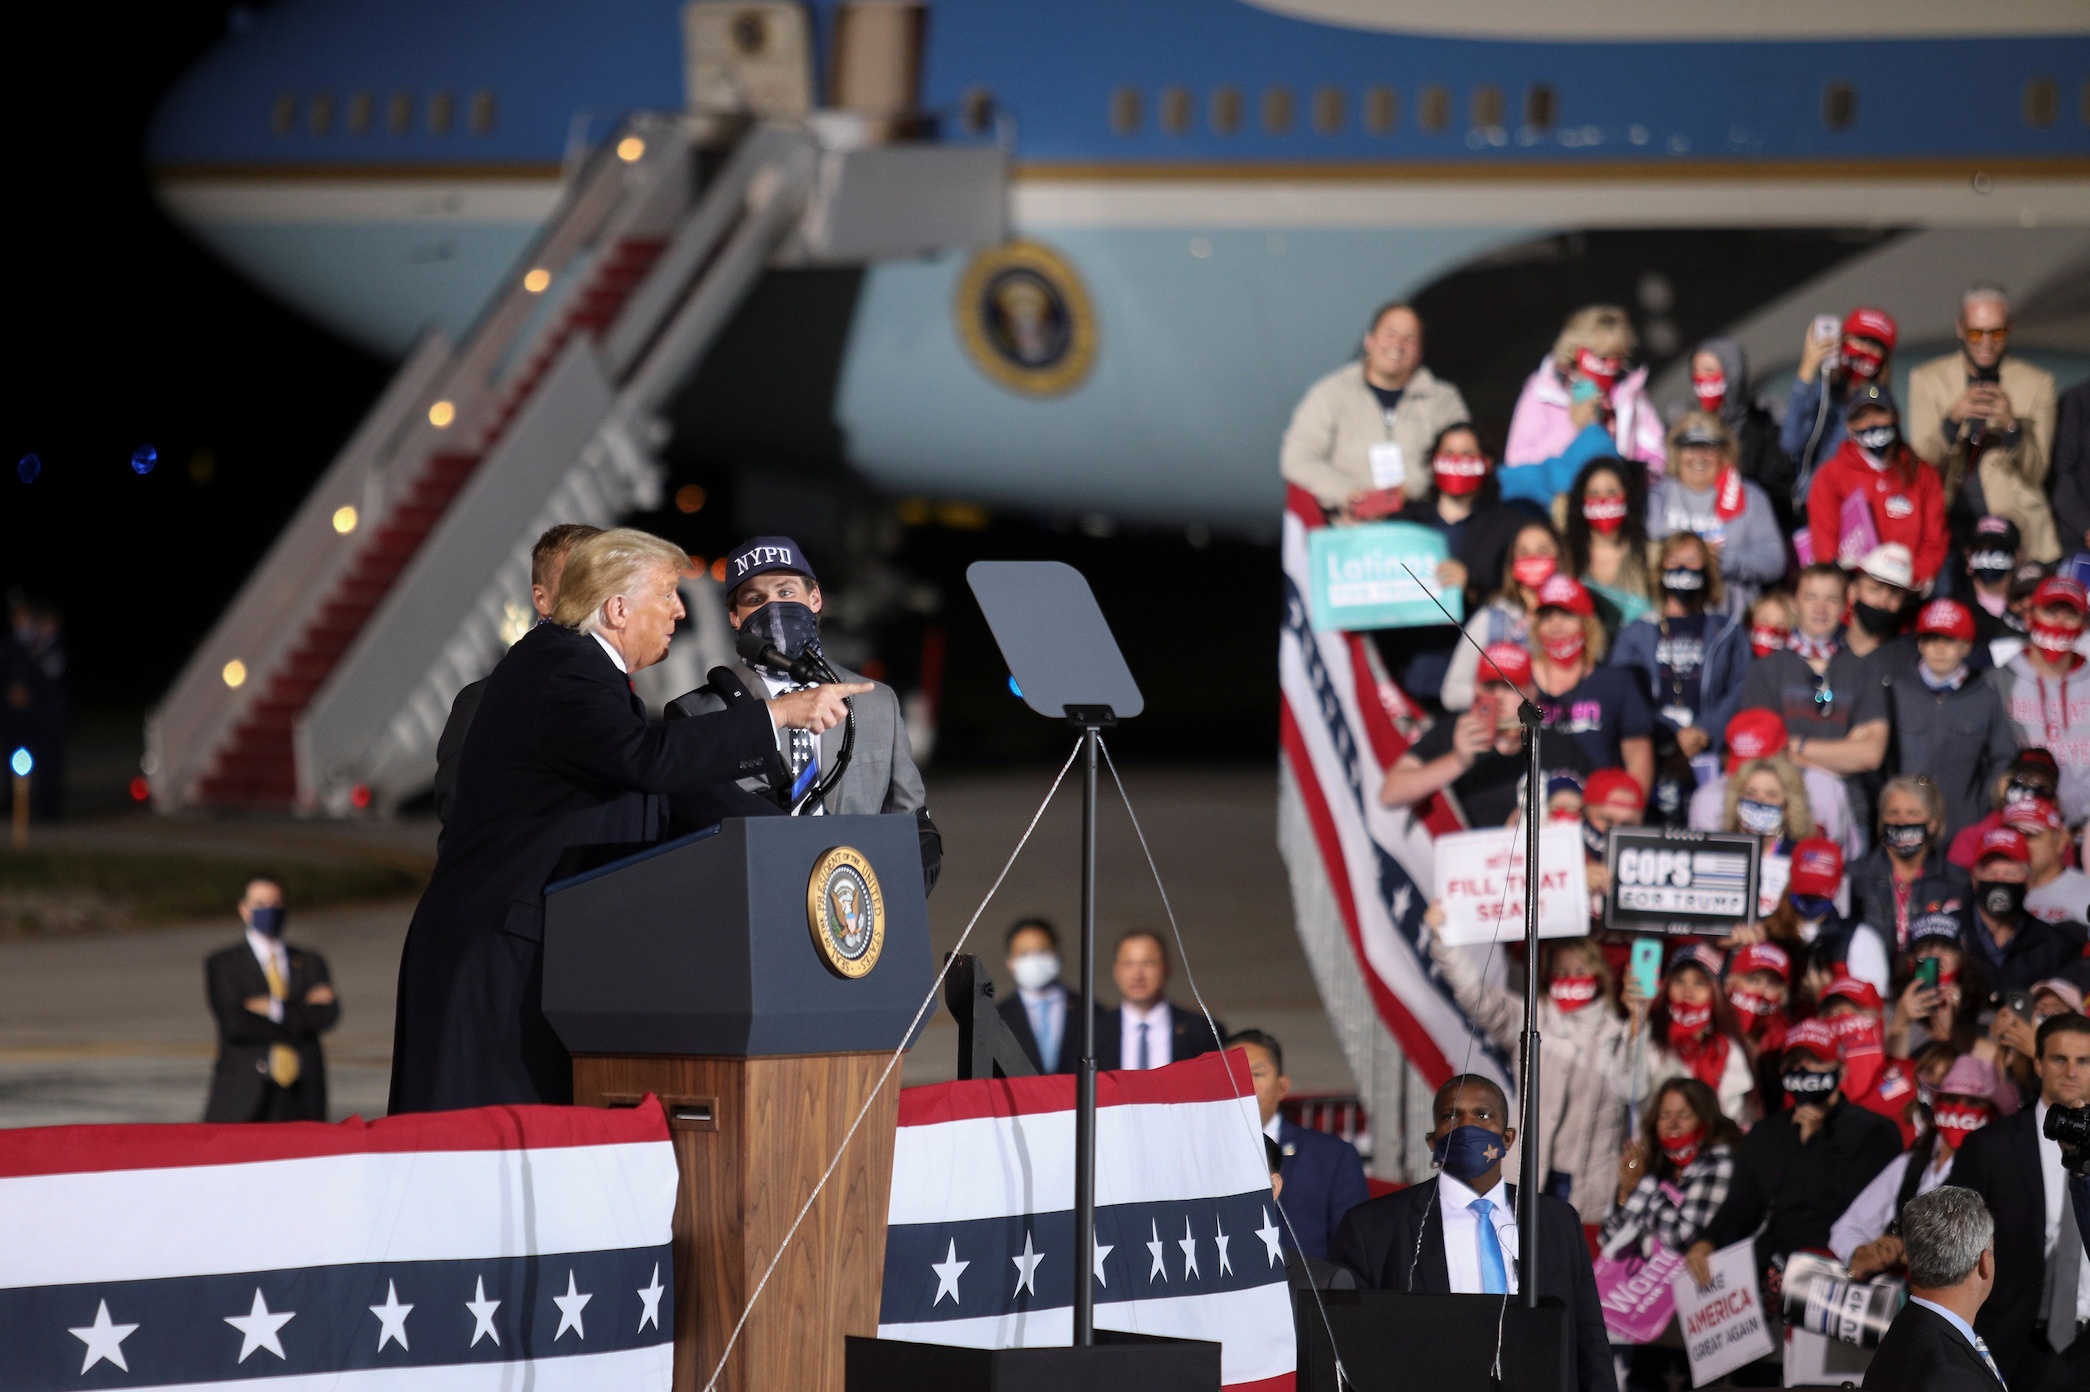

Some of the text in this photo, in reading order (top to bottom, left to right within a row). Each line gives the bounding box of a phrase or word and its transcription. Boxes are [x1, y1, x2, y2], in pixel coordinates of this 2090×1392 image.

[734, 547, 792, 576] NYPD
[1328, 551, 1439, 581] Latinos
[843, 852, 850, 861] OF
[1617, 847, 1691, 886] COPS
[817, 851, 842, 912] PRESIDENT
[861, 864, 882, 917] UNITED
[1447, 879, 1496, 897] FILL
[1476, 900, 1547, 922] SEA!
[1623, 891, 1738, 911] FOR TRUMP
[831, 946, 850, 972] SEAL
[861, 928, 881, 970] STATES
[1686, 1288, 1752, 1338] AMERICA
[1843, 1290, 1864, 1344] RUMP
[1692, 1316, 1759, 1362] GREAT AGAIN
